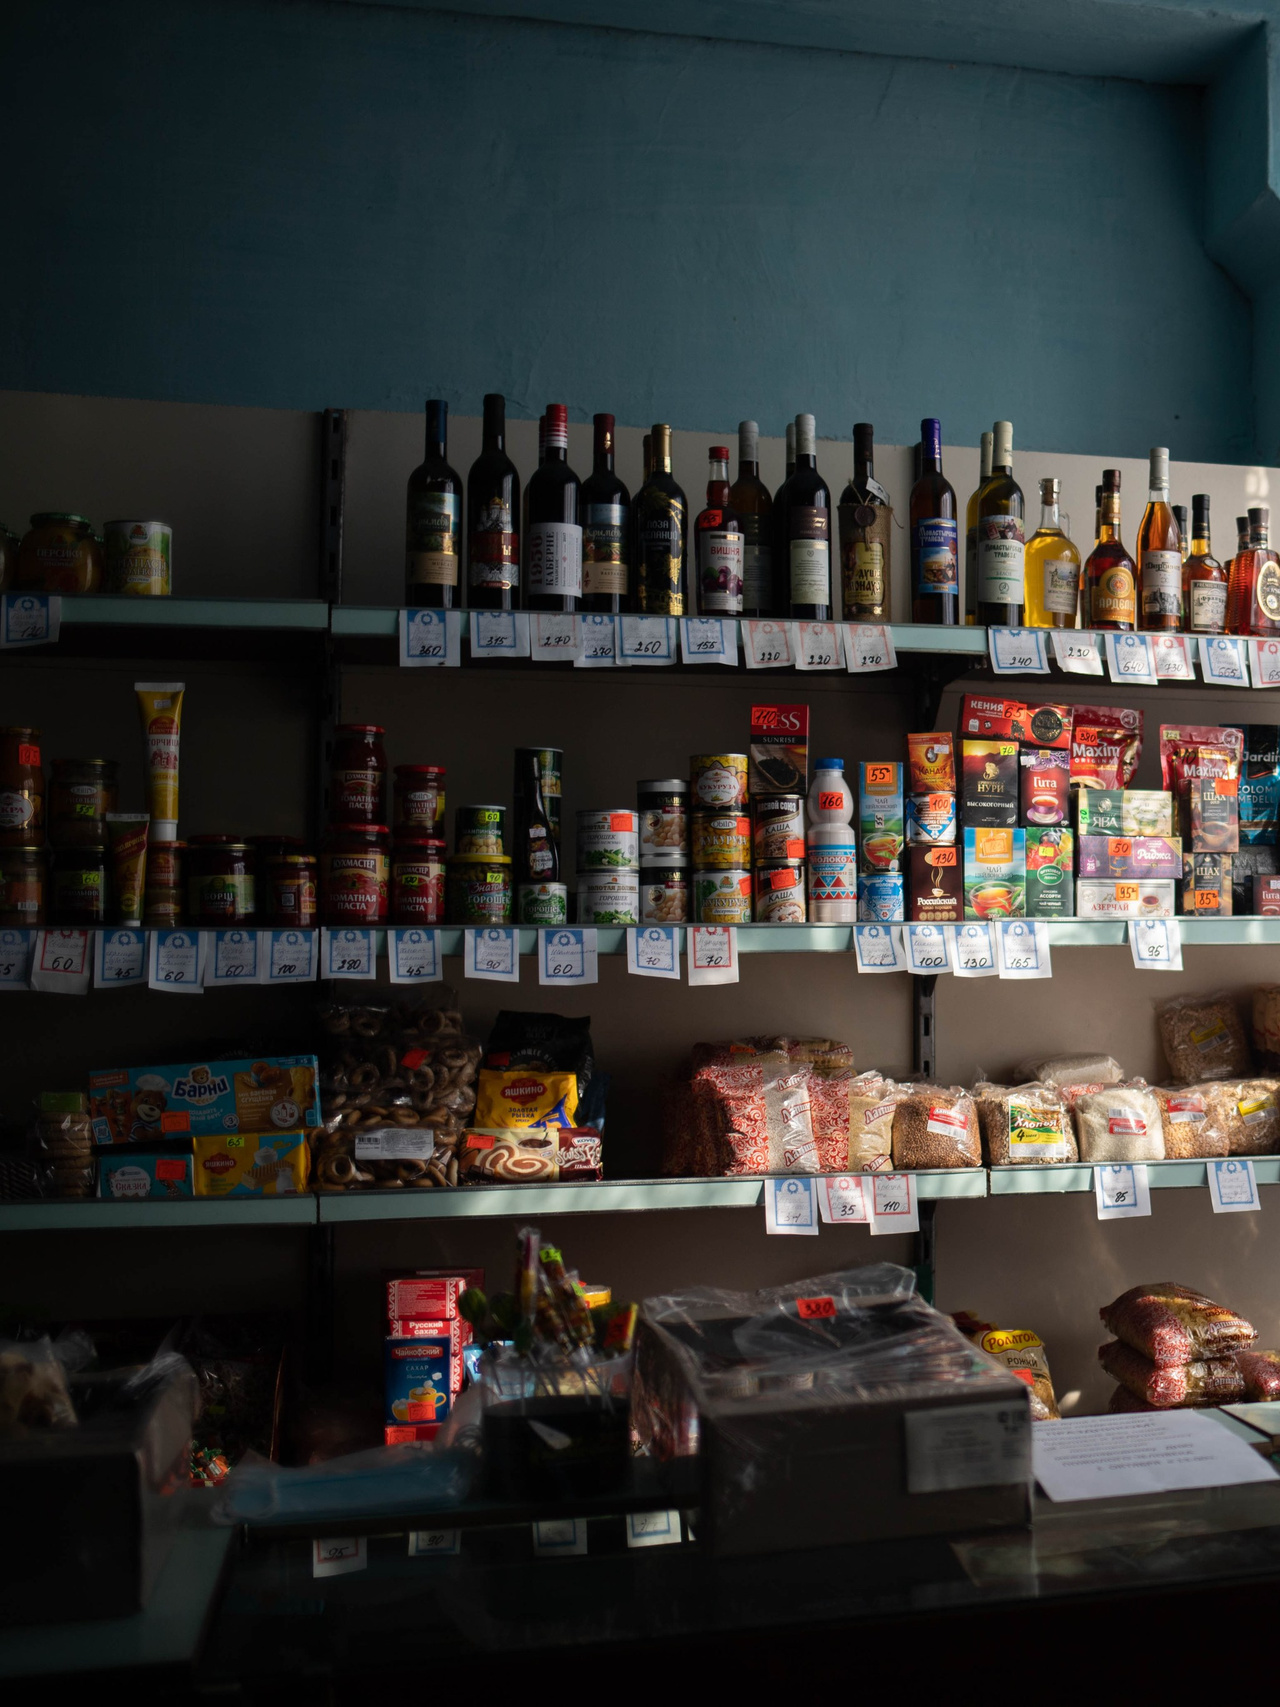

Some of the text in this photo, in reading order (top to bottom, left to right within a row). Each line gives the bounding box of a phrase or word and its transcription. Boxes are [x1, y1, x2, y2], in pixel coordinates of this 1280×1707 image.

[710, 546, 740, 555] ВИШНЯ
[546, 531, 554, 586] КАБЕРНЕ
[634, 641, 662, 654] 260
[970, 700, 1004, 712] КЕНИЯ
[755, 711, 777, 724] 110
[1004, 706, 1023, 719] 65
[1072, 741, 1120, 758] Maxim
[870, 767, 891, 782] 55
[1183, 764, 1223, 778] Maxim
[977, 784, 1004, 793] НУРИ
[1033, 776, 1057, 789] Гита
[822, 794, 842, 807] 160
[932, 799, 949, 811] 100
[1092, 816, 1119, 828] ЯВА
[765, 823, 790, 835] КАША
[1113, 842, 1129, 854] 50
[936, 852, 954, 865] 130
[1137, 848, 1172, 861] Раджа
[1087, 862, 1096, 870] 25
[1196, 867, 1220, 876] ШАХ
[768, 890, 794, 902] КАША
[917, 897, 957, 906] Российский
[337, 902, 367, 910] ПАСТА
[1091, 902, 1129, 912] АЗЕРЧАЙ
[52, 957, 74, 970] 60
[705, 955, 723, 966] 70
[919, 956, 943, 966] 100
[963, 957, 988, 968] 130
[1010, 957, 1031, 968] 165
[115, 968, 135, 978] 45
[225, 964, 245, 976] 60
[277, 964, 297, 975] 100
[406, 965, 425, 976] 45
[553, 964, 573, 975] 60
[164, 971, 185, 981] 60
[174, 1077, 229, 1098] Барни
[504, 1085, 544, 1096] ЯШКИНО
[227, 1138, 242, 1147] 65
[205, 1160, 235, 1168] ЯШКИНО
[840, 1204, 857, 1216] 35
[883, 1200, 901, 1212] 110
[408, 1321, 443, 1330] Русский
[413, 1328, 439, 1336] сахар
[986, 1332, 1037, 1351] РОЛЛТОН
[394, 1347, 440, 1357] Чайкофский
[1007, 1357, 1038, 1368] РОЖКИ
[325, 1545, 350, 1560] 95
